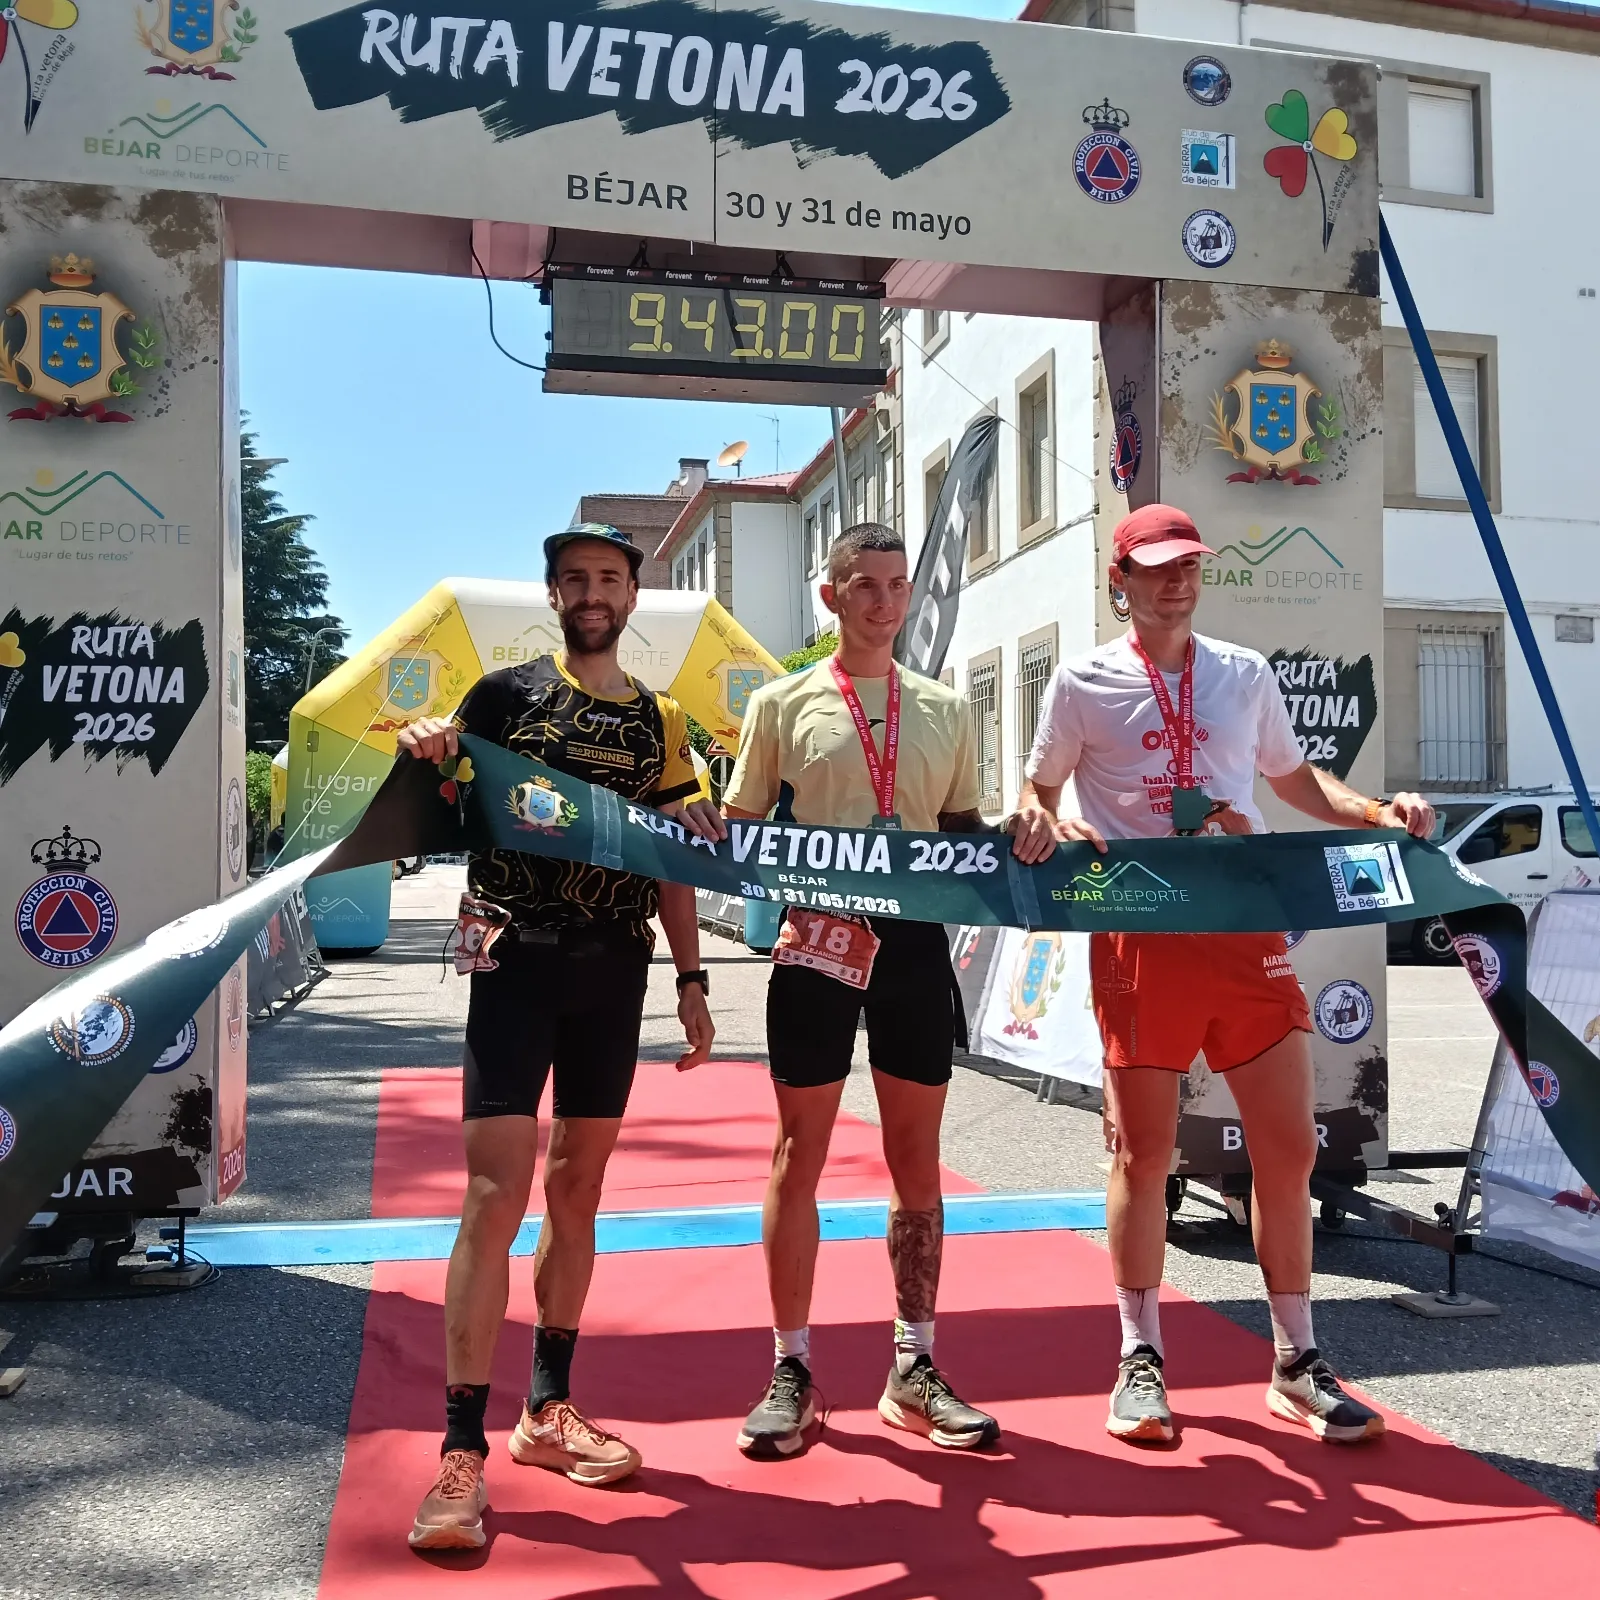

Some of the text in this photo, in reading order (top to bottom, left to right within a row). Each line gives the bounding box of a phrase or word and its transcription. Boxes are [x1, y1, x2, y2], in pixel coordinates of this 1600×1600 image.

[32, 33, 67, 99] ruta vetona
[360, 9, 978, 120] RUTA VETONA 2026
[176, 144, 289, 172] DEPORTE
[1075, 134, 1139, 180] PROTECCION CIVIL
[1181, 143, 1190, 175] SIERRA
[189, 171, 205, 180] tus
[1181, 175, 1220, 188] de Béjar
[1332, 164, 1350, 198] vetona
[568, 171, 972, 240] BÉJAR 30 y 31 de mayo
[60, 520, 191, 545] DEPORTE
[56, 550, 72, 560] de
[76, 551, 94, 561] tus
[1201, 560, 1363, 591] ÉJAR DEPORTE
[1263, 594, 1275, 604] de
[1277, 595, 1292, 604] tus
[70, 625, 156, 660] RUTA
[42, 664, 185, 704] VETONA
[1275, 660, 1338, 690] RUTA
[1183, 697, 1191, 721] VETONA
[1281, 694, 1360, 728] TONA
[72, 712, 156, 744] 2026
[889, 723, 898, 745] VETONA
[583, 748, 635, 766] RUNNERS
[303, 767, 377, 796] Lugar
[302, 793, 331, 815] de
[884, 783, 893, 809] VETONA
[731, 823, 892, 874] VETONA
[908, 840, 999, 875] 2026
[1324, 847, 1347, 856] club
[740, 880, 766, 898] 30
[768, 888, 781, 901] y
[785, 888, 807, 904] 31
[778, 873, 828, 887] BÉJAR
[1328, 863, 1347, 900] SIERRA
[20, 876, 114, 933] PROTECCION CIVIL
[1111, 889, 1190, 902] DEPORTE
[1114, 904, 1124, 912] de
[1338, 896, 1390, 910] de Béjar
[463, 905, 485, 917] VETONA
[807, 918, 852, 955] 18
[40, 948, 94, 966] BEJAR
[800, 944, 844, 963] ALEJANDRO
[125, 1004, 136, 1024] GRUPO
[80, 1057, 113, 1067] MONTAÑA
[112, 1050, 122, 1060] DE
[223, 1145, 242, 1185] 2026
[51, 1167, 134, 1198] JAR
